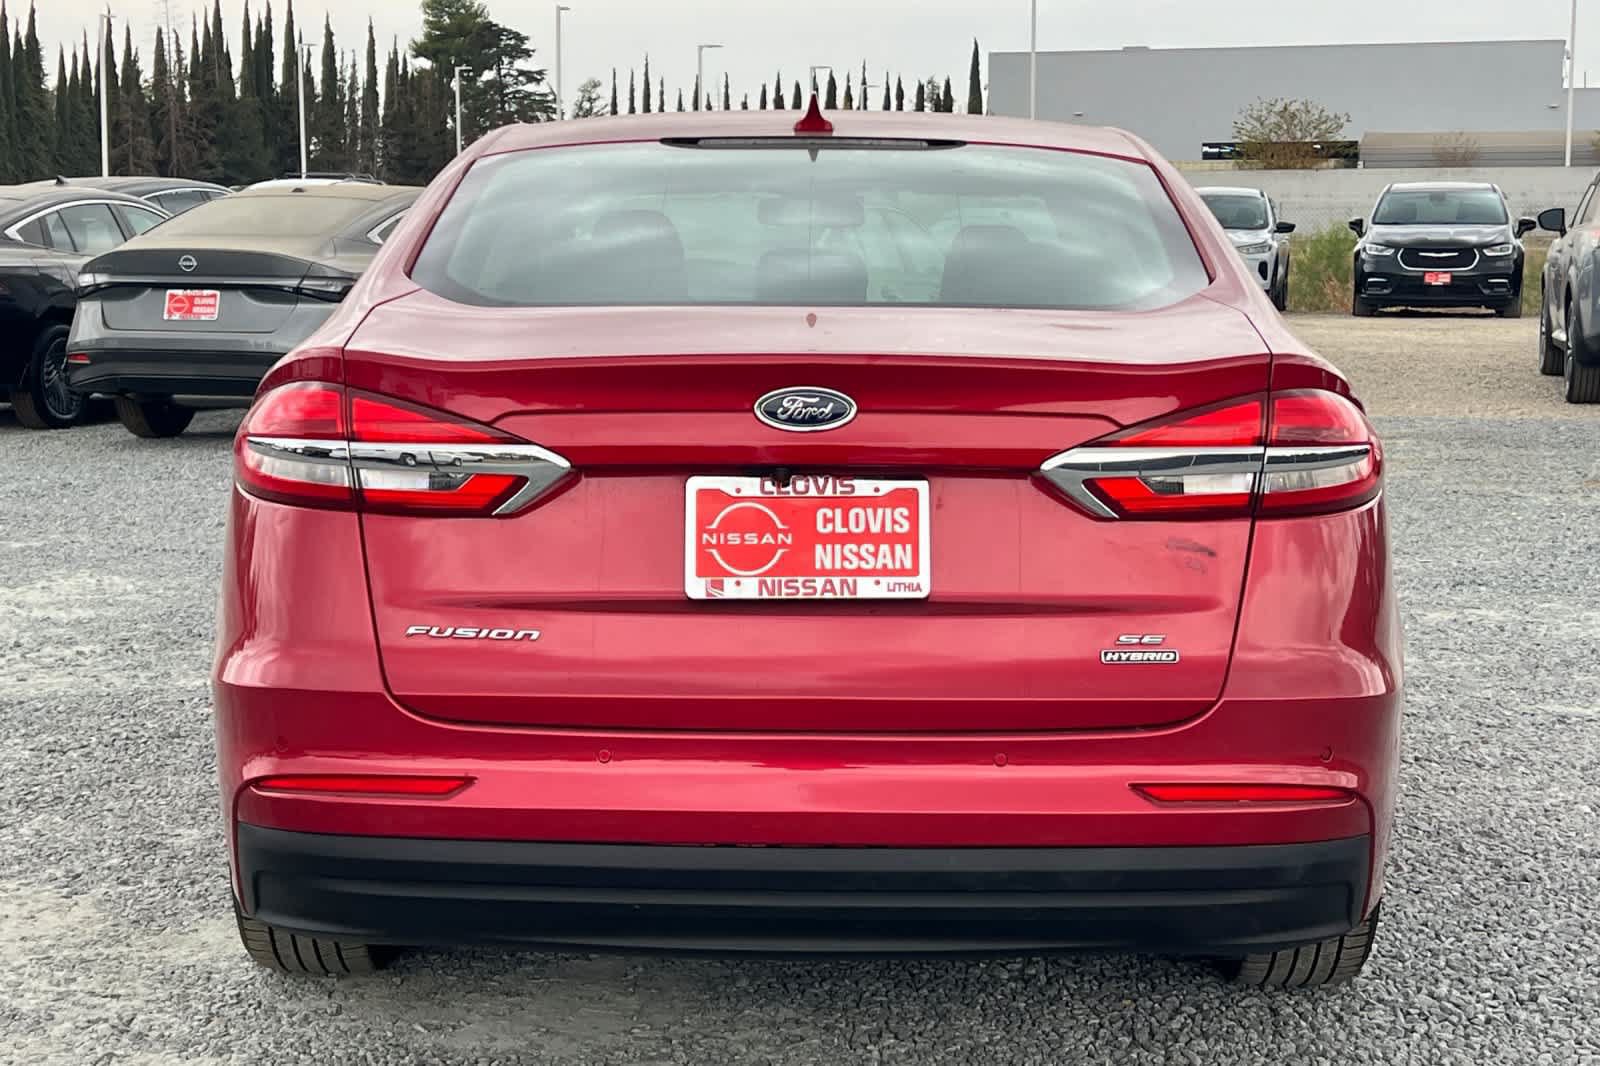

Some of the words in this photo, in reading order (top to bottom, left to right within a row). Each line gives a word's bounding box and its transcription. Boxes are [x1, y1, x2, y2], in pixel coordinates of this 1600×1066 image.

[777, 396, 834, 420] Ford
[816, 507, 910, 534] CLOVIS
[702, 533, 792, 545] NISSAN
[815, 543, 913, 570] NISSAN
[758, 578, 857, 597] NISSAN
[887, 582, 922, 593] LITHIA
[1115, 633, 1166, 644] SE
[1105, 652, 1175, 661] HYBRID
